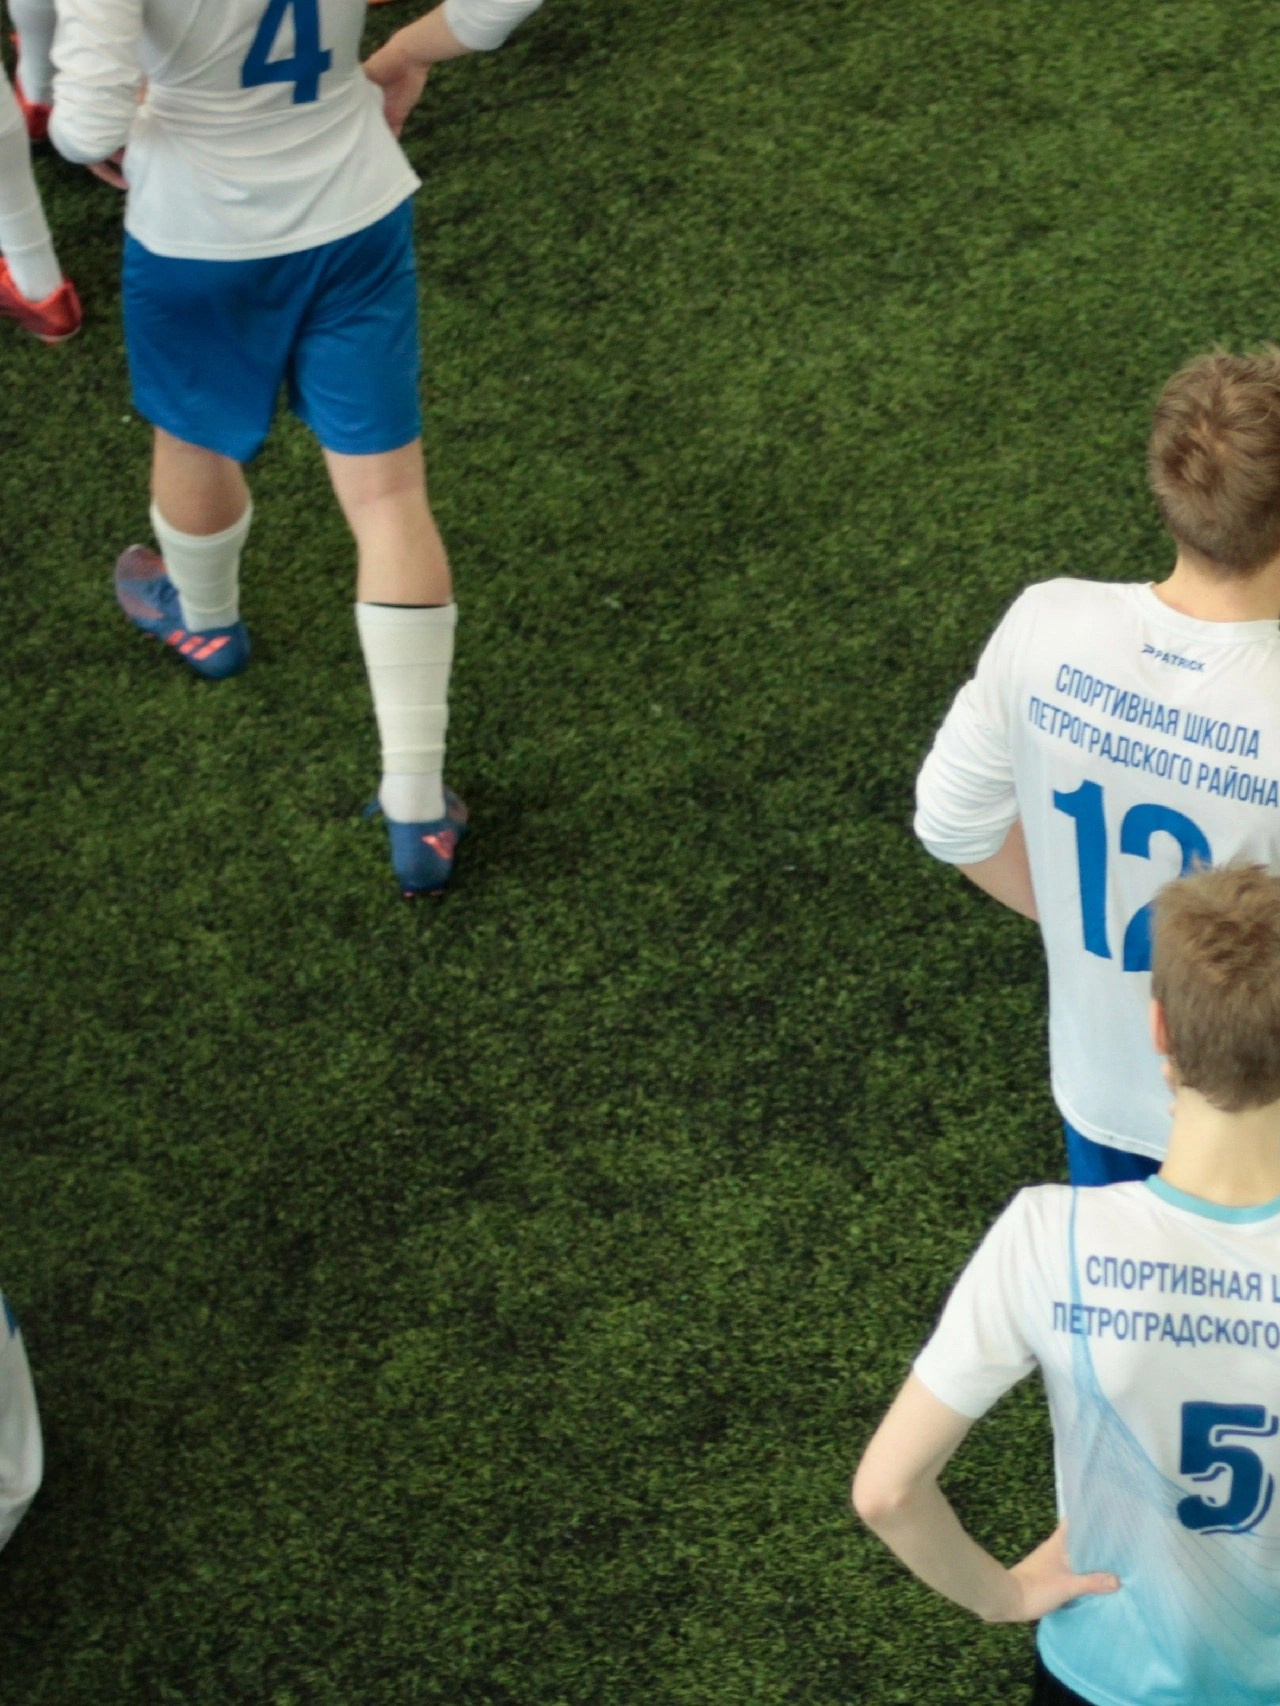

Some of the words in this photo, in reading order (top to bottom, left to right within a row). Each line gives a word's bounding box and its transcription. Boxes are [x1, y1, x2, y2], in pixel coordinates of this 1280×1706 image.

[241, 0, 332, 104] 4
[1055, 663, 1180, 736] СПОРТИВНАЯ
[1183, 714, 1261, 760] ШКОЛА
[1153, 649, 1206, 673] PATRICK
[1028, 696, 1192, 786] ПЕТРОГРАДСКОГО
[1198, 762, 1279, 808] РАЙОНА
[1052, 779, 1213, 973] 12
[1086, 1255, 1262, 1302] СПОРТИВНАЯ
[1176, 1401, 1280, 1535] 5
